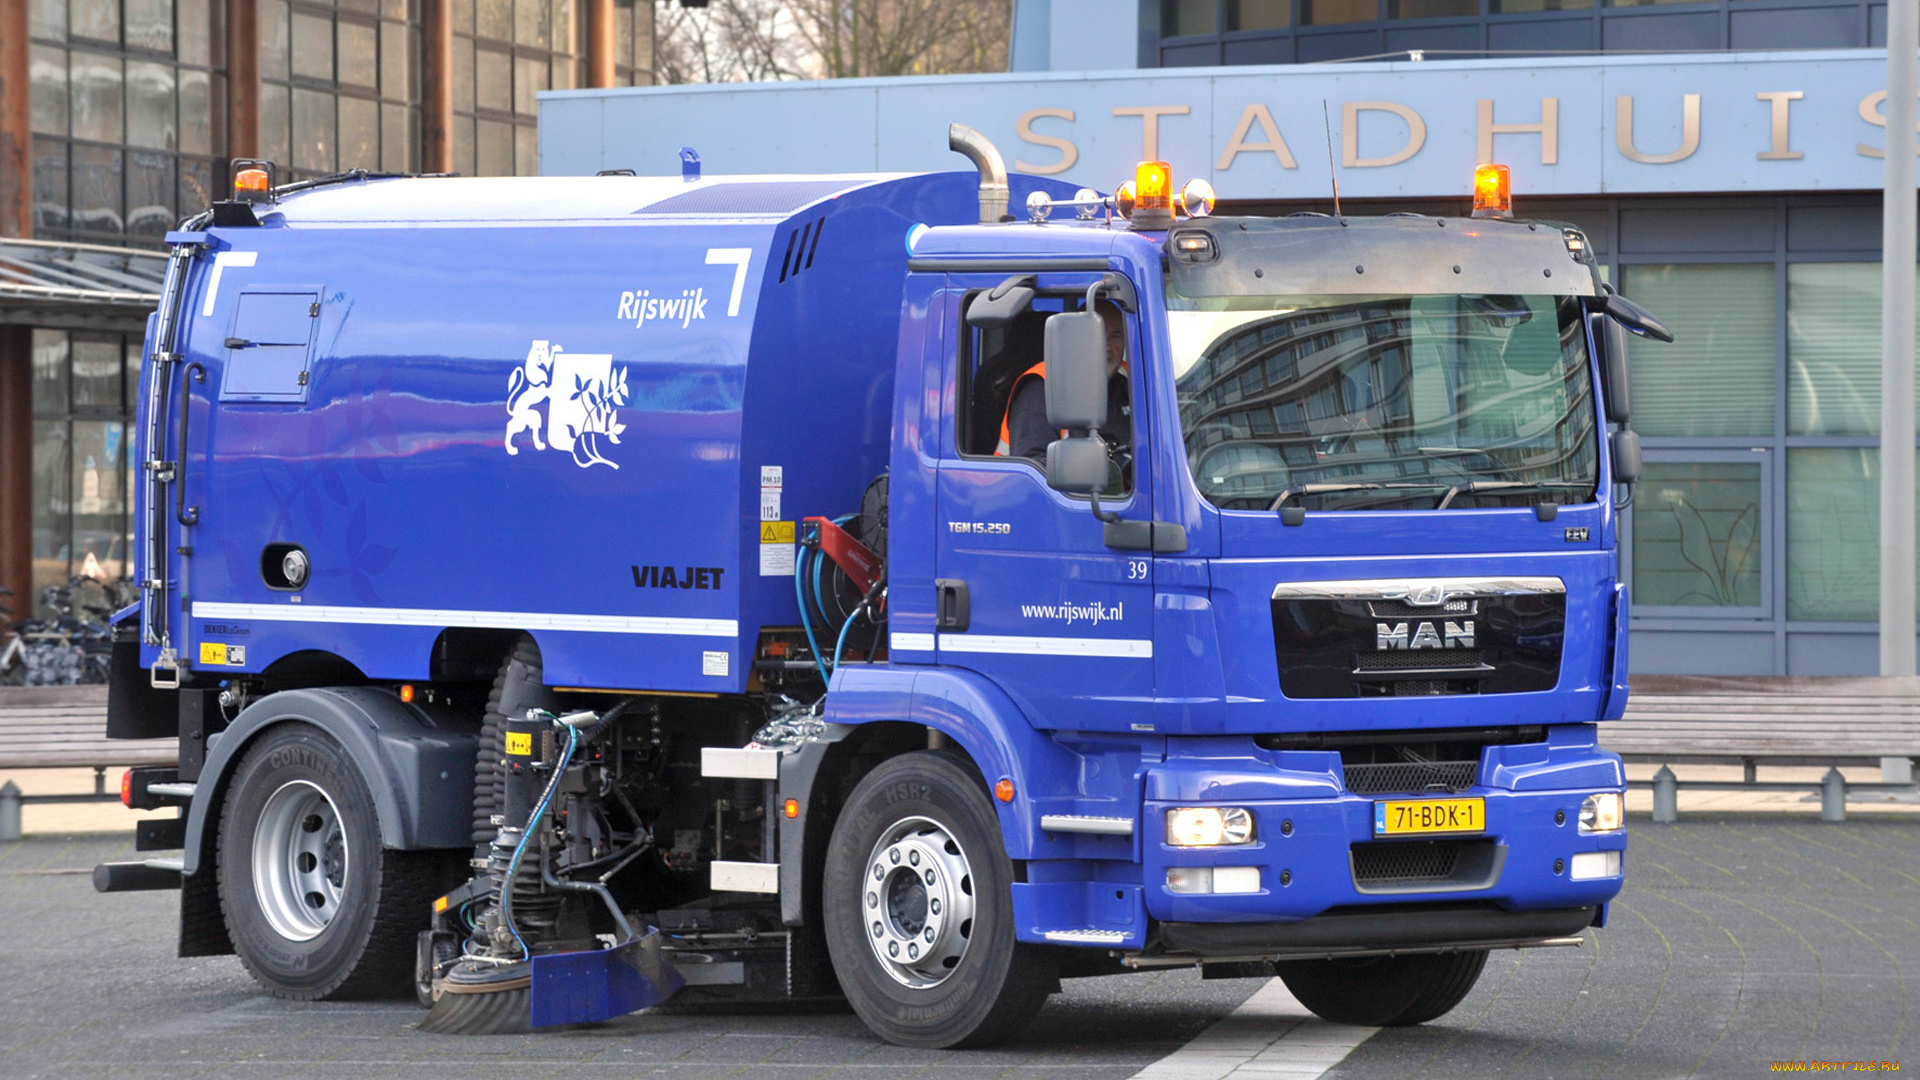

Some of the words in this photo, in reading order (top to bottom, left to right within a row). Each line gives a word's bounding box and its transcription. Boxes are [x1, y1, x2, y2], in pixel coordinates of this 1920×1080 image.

[617, 287, 708, 329] Rijswijk
[948, 521, 971, 533] TGM
[972, 522, 1011, 535] 15.250
[631, 565, 725, 590] VIAJET
[1128, 561, 1147, 579] 39
[1021, 601, 1123, 626] www.rijswijk.nl
[1377, 621, 1475, 650] MAN
[1376, 821, 1385, 829] NL
[1396, 804, 1483, 828] 71-BDK-1
